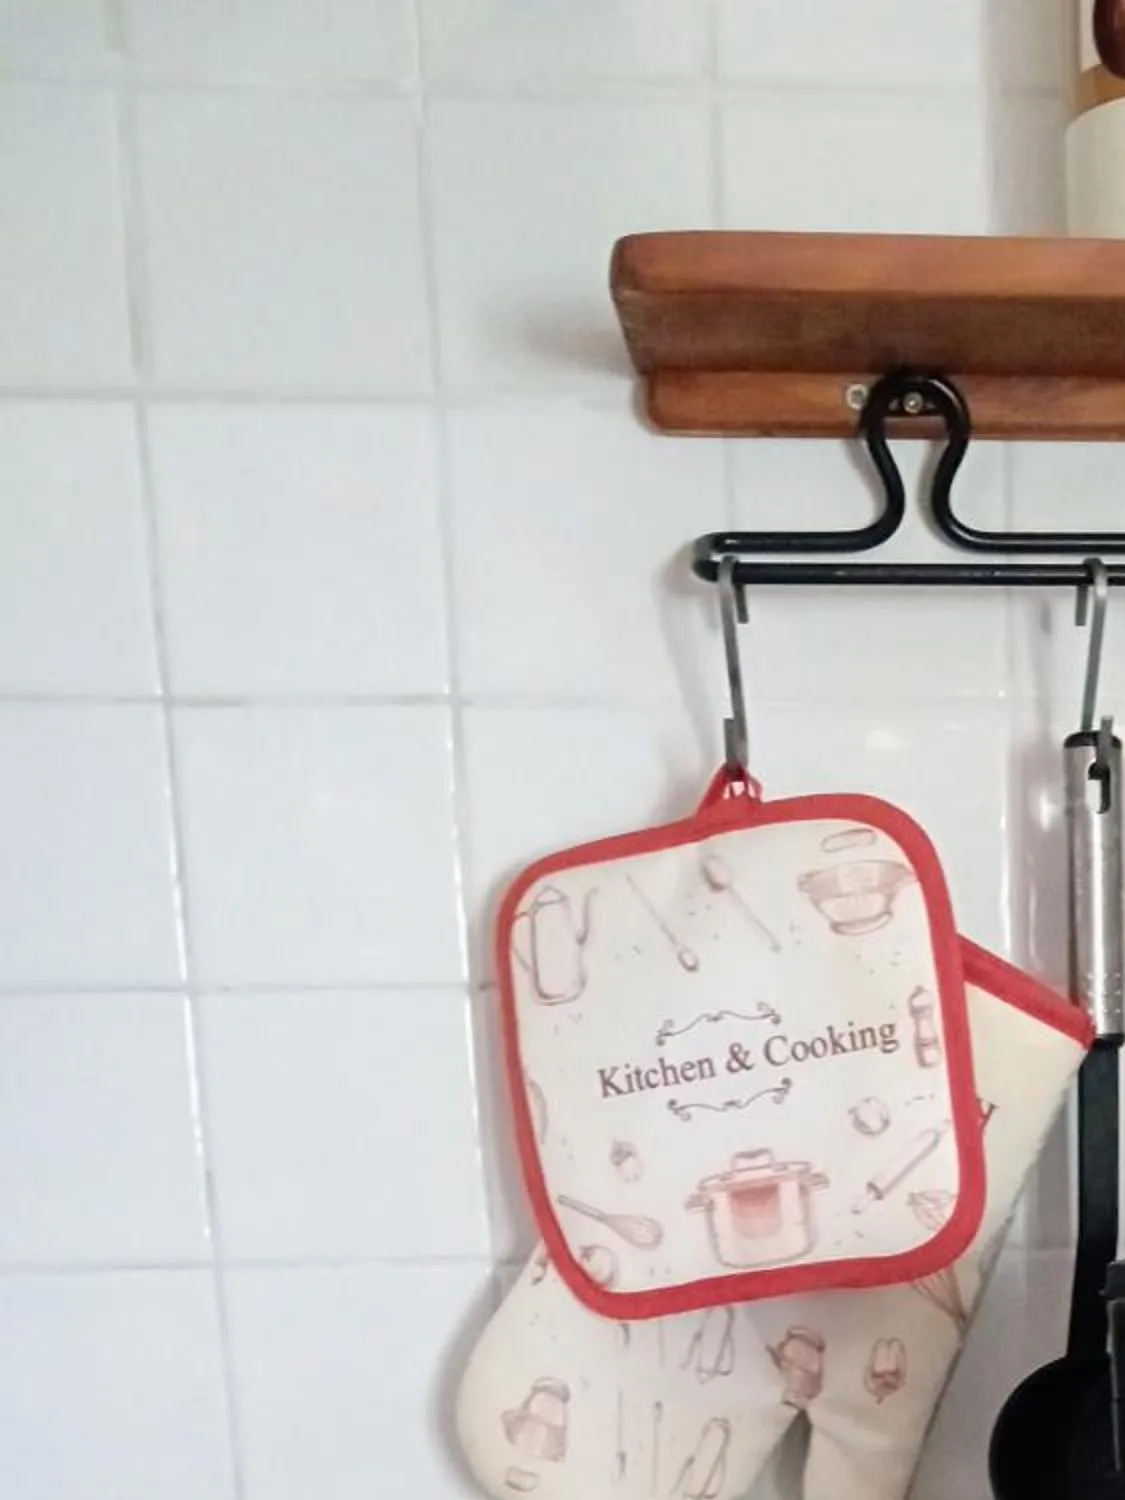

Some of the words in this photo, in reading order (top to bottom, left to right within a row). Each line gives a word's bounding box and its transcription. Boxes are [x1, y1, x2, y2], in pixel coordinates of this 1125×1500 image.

[597, 1056, 716, 1099] Kitchen
[725, 1042, 755, 1074] &
[763, 1020, 900, 1067] Cooking
